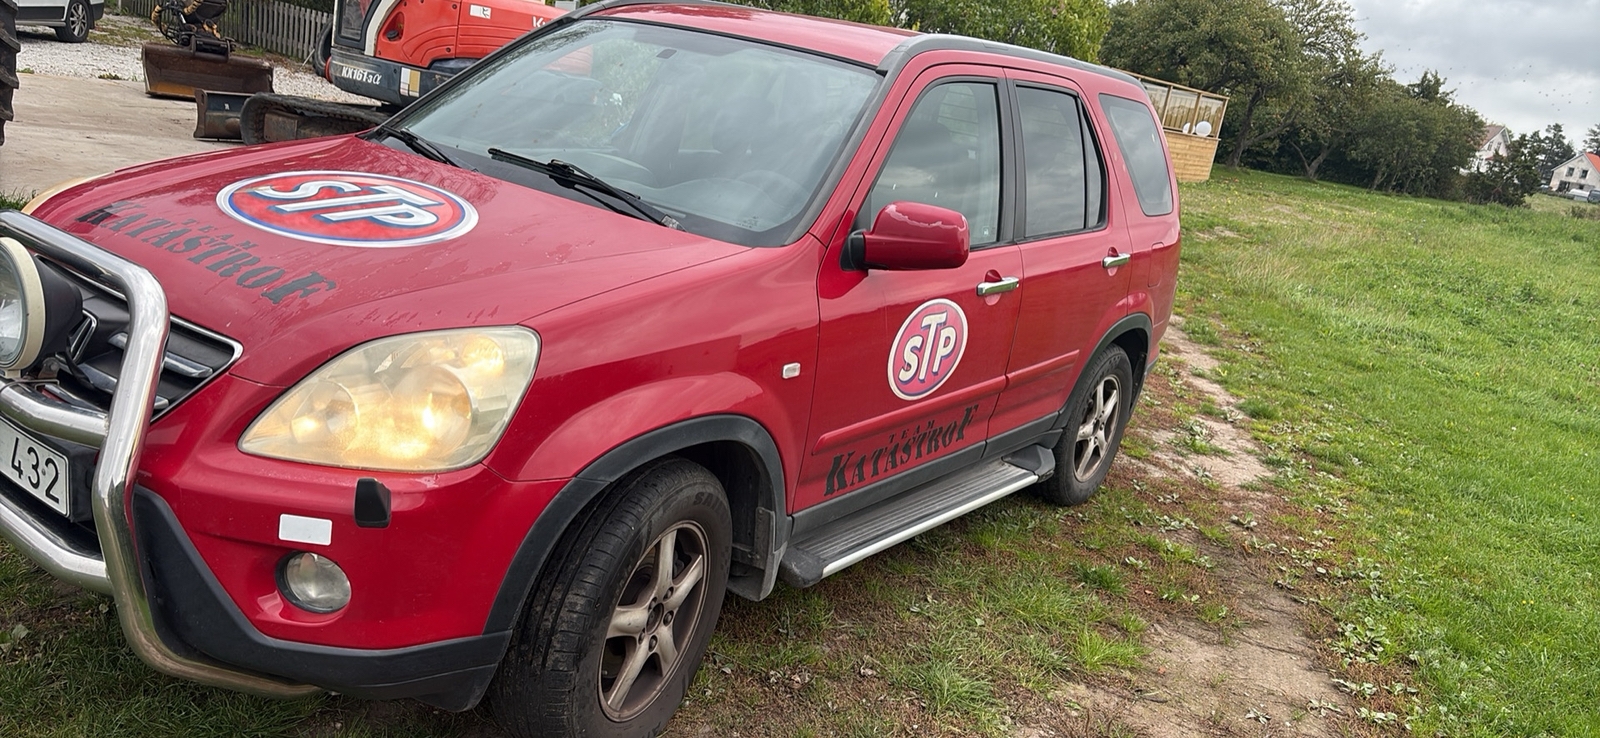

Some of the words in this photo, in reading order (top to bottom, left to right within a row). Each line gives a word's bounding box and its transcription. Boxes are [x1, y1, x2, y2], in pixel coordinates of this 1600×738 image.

[249, 180, 444, 229] STP
[181, 217, 259, 250] TEAM
[898, 310, 957, 385] STP
[889, 420, 935, 444] TEAM
[11, 437, 60, 505] 432
